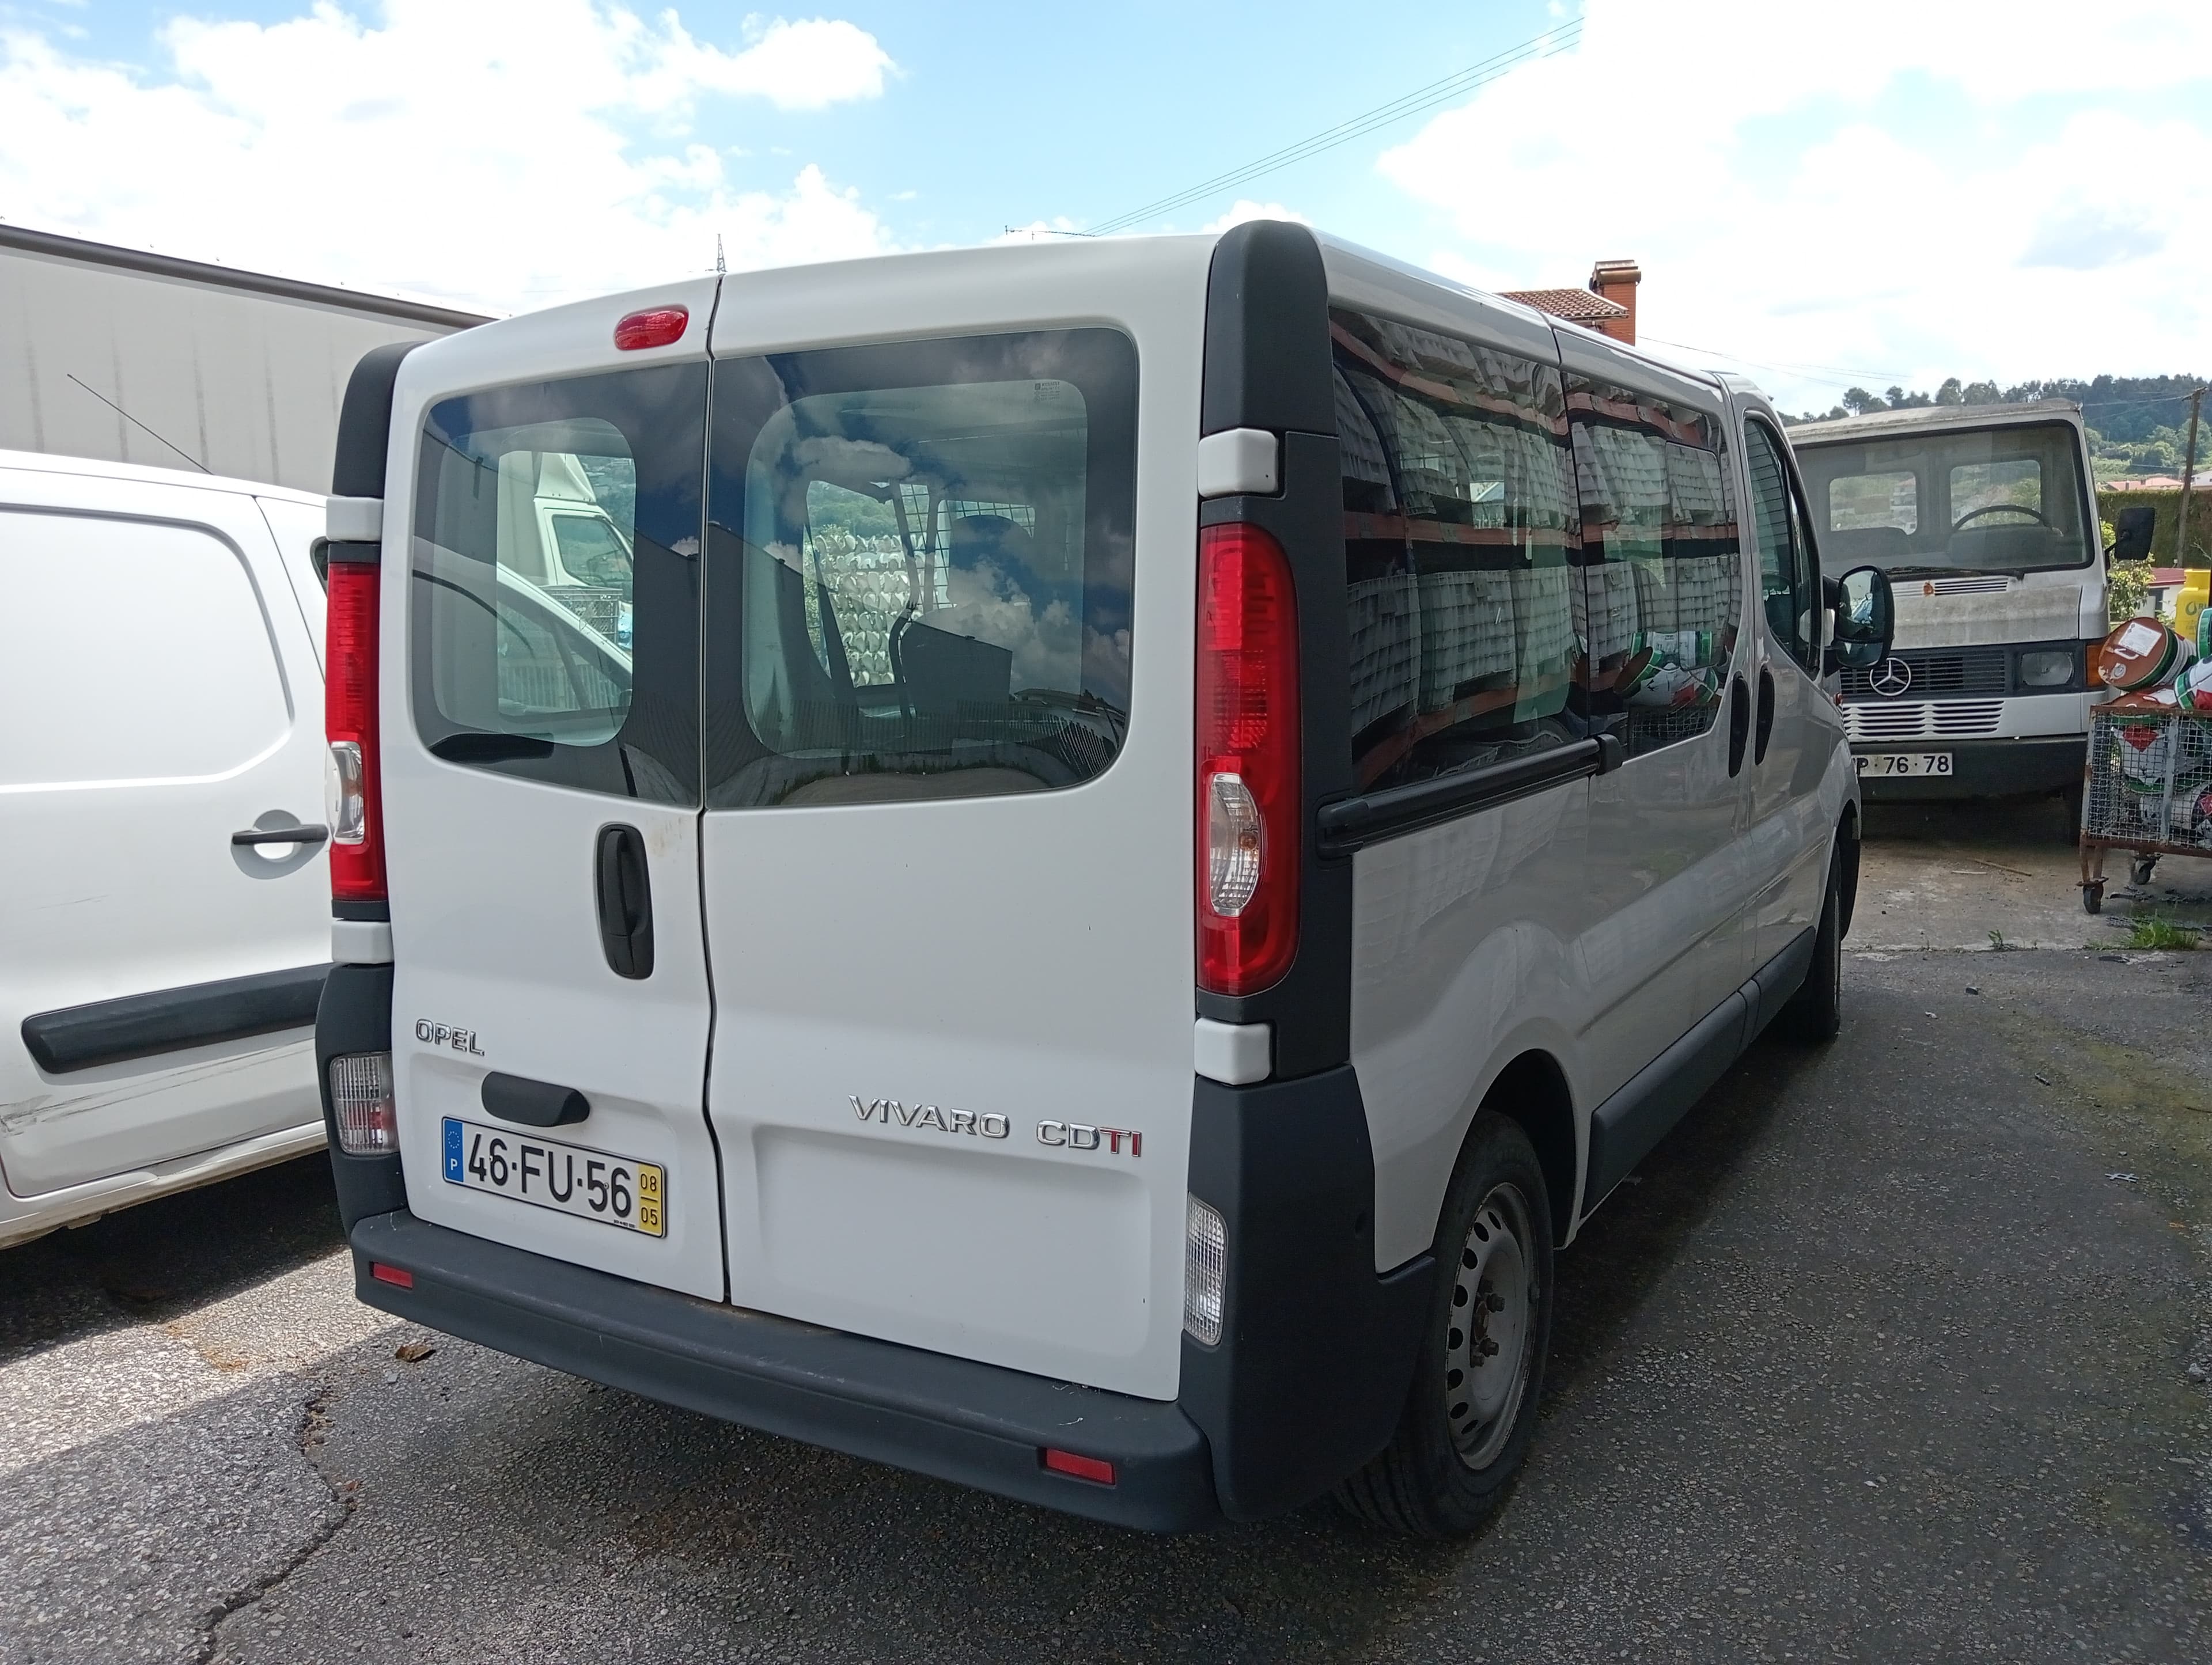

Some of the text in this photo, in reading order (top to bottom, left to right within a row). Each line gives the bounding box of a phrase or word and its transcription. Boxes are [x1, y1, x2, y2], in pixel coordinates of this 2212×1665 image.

[416, 1019, 485, 1056] OPEL
[848, 1094, 1142, 1158] VIVARO CDTI
[450, 1159, 459, 1171] P
[640, 1173, 657, 1192] 08
[641, 1207, 658, 1226] 05
